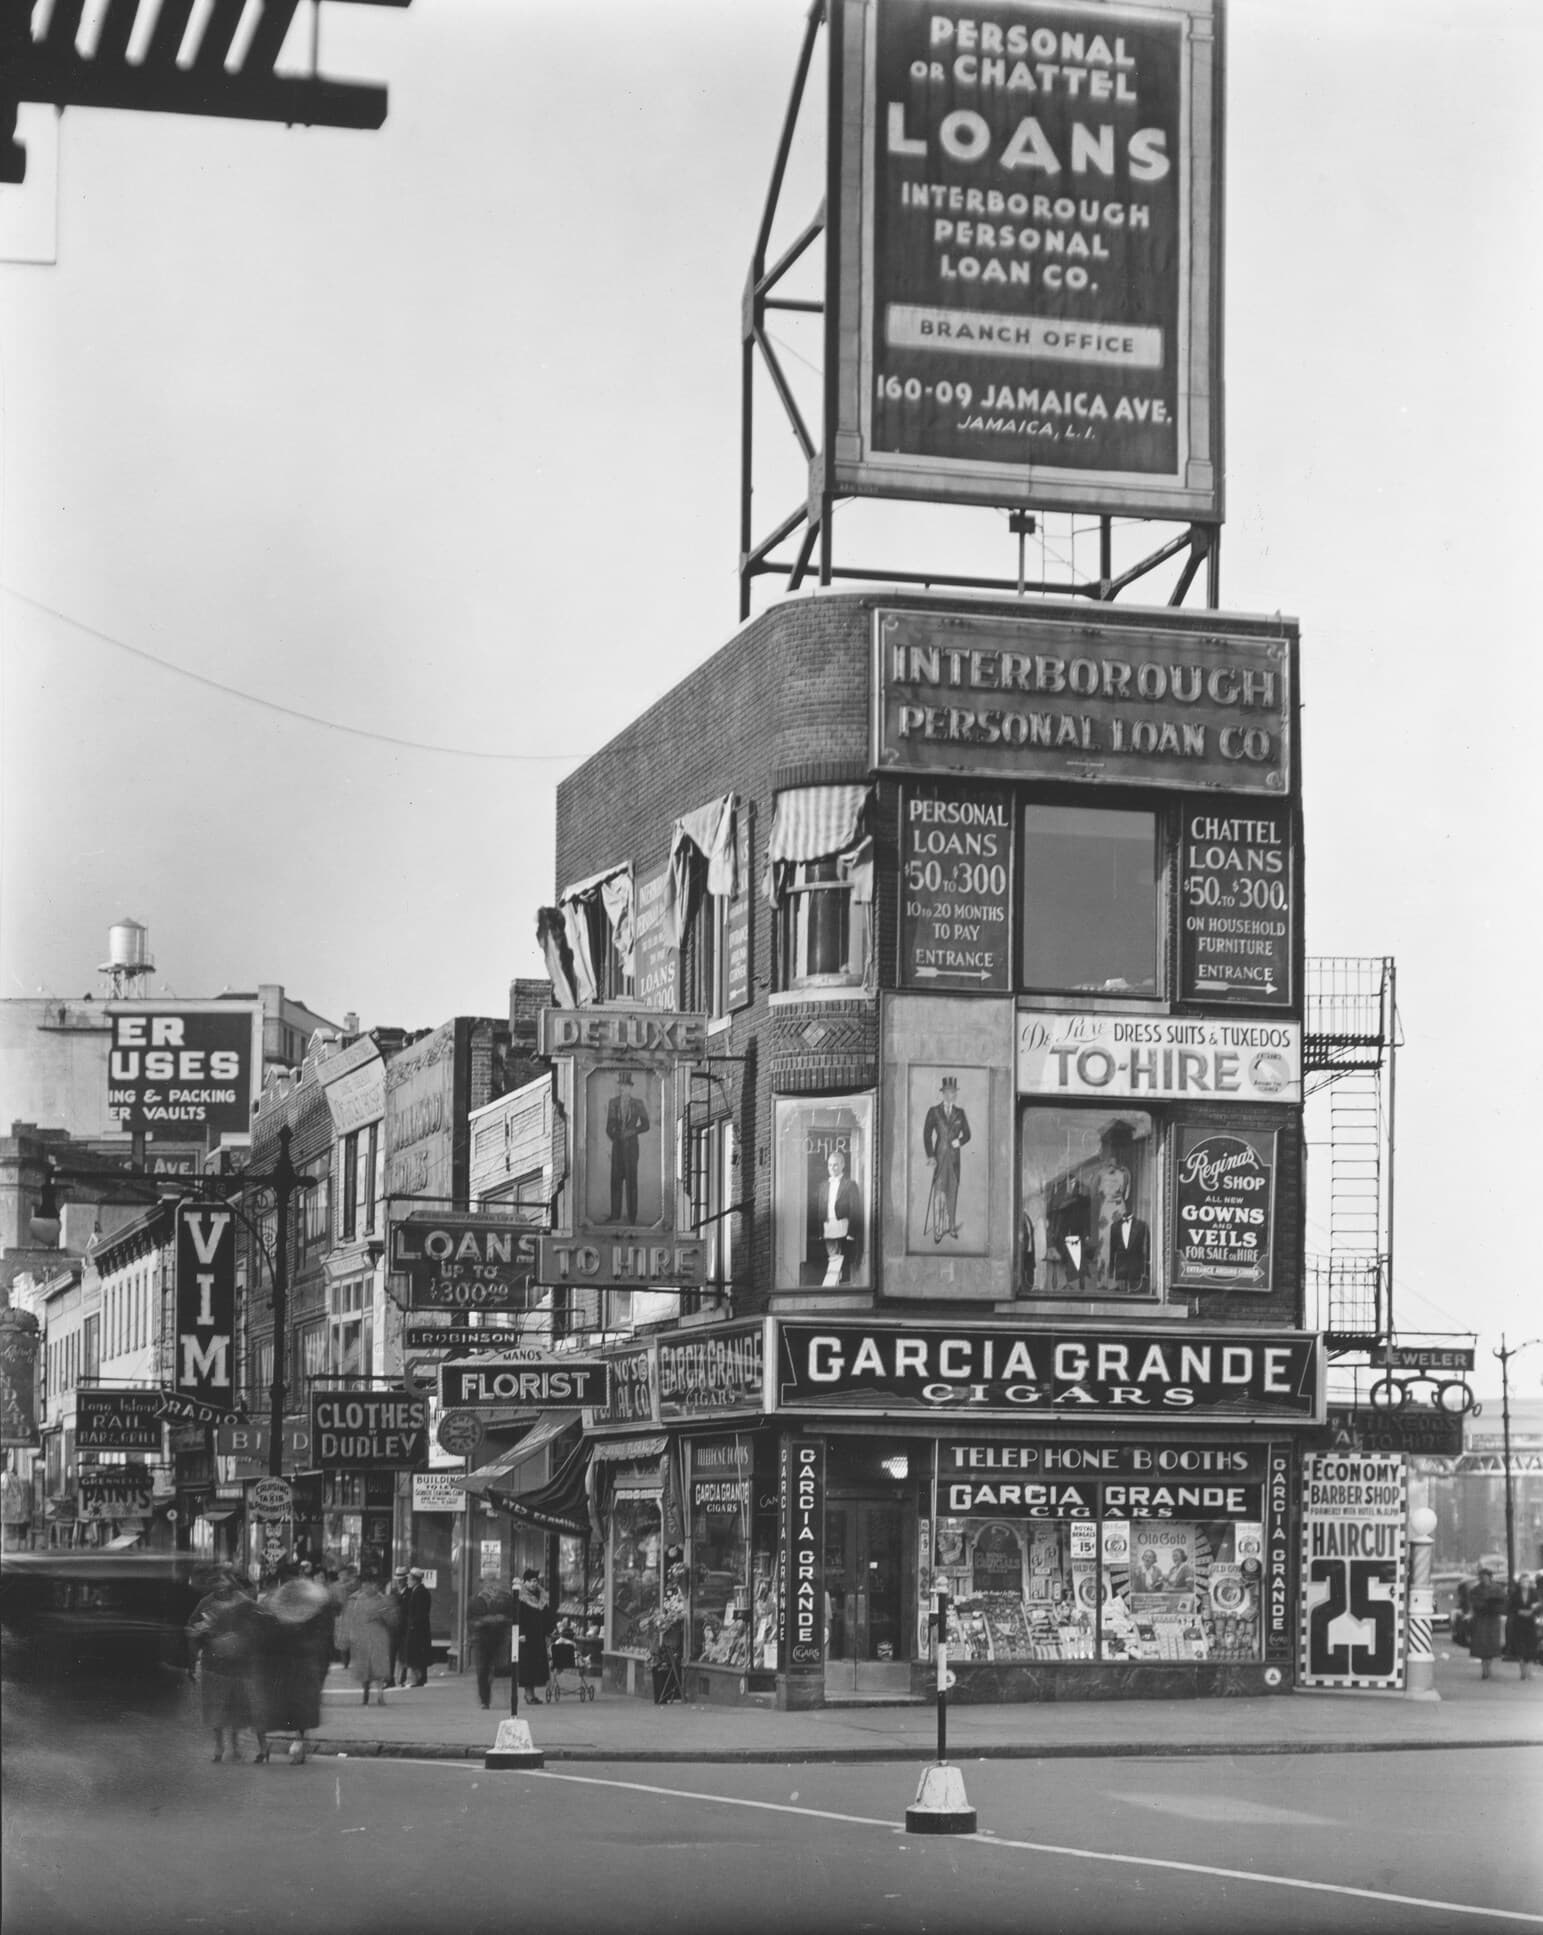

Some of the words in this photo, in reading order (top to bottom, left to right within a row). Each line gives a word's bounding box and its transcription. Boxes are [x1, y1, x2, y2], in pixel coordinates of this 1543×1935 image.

[930, 15, 1136, 66] PERSONAL
[910, 59, 945, 81] OR
[954, 53, 1138, 101] CHATTEL
[886, 100, 1171, 182] LOANS
[900, 180, 1150, 229] INTERBOROUGH
[934, 217, 1110, 259] PERSONAL
[939, 254, 1030, 284] LOAN
[1042, 263, 1099, 291] CO.
[920, 319, 1031, 345] BRANCH
[1042, 330, 1135, 354] OFFICE
[877, 374, 973, 409] 160-09
[979, 384, 1109, 422] JAMAICA
[1113, 396, 1173, 425] AVE.
[956, 415, 1060, 440] JAMAICA,
[892, 644, 1275, 707] INTERBOROUGH
[897, 704, 1101, 750] PERSONAL
[1112, 718, 1206, 756] LOAN
[909, 799, 1009, 827] PERSONAL
[1191, 816, 1281, 844] CHATTEL
[913, 829, 997, 857] LOANS
[1189, 846, 1283, 873] LOANS
[904, 860, 942, 891] $50
[953, 862, 1006, 895] $300
[906, 901, 921, 917] 10
[933, 903, 952, 919] 20
[954, 904, 1005, 922] MONTHS
[933, 922, 950, 940] TO
[953, 924, 980, 941] PAY
[1186, 916, 1204, 931] ON
[1208, 918, 1286, 936] HOUSEHOLD
[916, 948, 994, 968] ENTRANCE
[1197, 937, 1273, 956] FURNITURE
[1198, 965, 1275, 981] ENTRANCE
[118, 1016, 186, 1047] ER
[554, 1018, 600, 1049] DE
[611, 1019, 699, 1051] LUXE
[1113, 1023, 1162, 1043] DRESS
[1167, 1026, 1205, 1045] SUITS
[1209, 1033, 1218, 1045] &
[1221, 1027, 1290, 1047] TUXEDOS
[111, 1051, 240, 1081] USES
[110, 1089, 137, 1104] ING
[144, 1089, 162, 1103] &
[168, 1089, 237, 1104] PACKING
[110, 1106, 132, 1121] ER
[142, 1106, 207, 1121] VAULTS
[153, 1158, 195, 1176] AVE.
[1223, 1175, 1266, 1191] SHOP
[1205, 1195, 1221, 1203] ALL
[1224, 1196, 1244, 1204] NEW
[1181, 1205, 1265, 1224] GOWNS
[396, 1230, 535, 1264] LOANS
[1188, 1229, 1258, 1248] VEILS
[553, 1244, 601, 1277] TO
[612, 1246, 697, 1277] HIRE
[1186, 1246, 1205, 1259] FOR
[1206, 1248, 1229, 1261] SALE
[1237, 1249, 1260, 1262] HIRE
[441, 1264, 464, 1279] UP
[473, 1264, 498, 1279] TO
[180, 1211, 231, 1387] VIM
[421, 1332, 516, 1344] ROBINSON
[503, 1350, 542, 1361] MANOS
[661, 1344, 707, 1397] GARCIA
[707, 1332, 762, 1388] GRANDE
[807, 1336, 1040, 1382] GARCIA
[1053, 1342, 1293, 1393] GRANDE
[1377, 1352, 1468, 1366] JEWELER
[461, 1371, 591, 1401] FLORIST
[685, 1391, 735, 1406] CIGARS
[921, 1384, 1196, 1407] CIGARS
[92, 1414, 147, 1430] RAIL
[166, 1400, 239, 1427] RADIO
[317, 1402, 424, 1429] CLOTHES
[231, 1431, 309, 1451] BID
[321, 1432, 417, 1458] DUDLEY
[1132, 1449, 1249, 1471] BOOTHS
[1311, 1460, 1400, 1482] ECONOMY
[81, 1488, 151, 1512] PAINTS
[255, 1482, 289, 1496] CRUISING
[261, 1495, 284, 1504] TAXIS
[696, 1483, 720, 1506] GARCIA
[721, 1481, 750, 1505] GRANDE
[798, 1449, 817, 1540] GARCIA
[949, 1484, 1085, 1511] GARCIA
[1105, 1486, 1247, 1512] GRANDE
[1272, 1458, 1287, 1540] GARCIA
[1310, 1485, 1363, 1505] BARBER
[1364, 1485, 1400, 1505] SHOP
[501, 1498, 528, 1515] EYES
[706, 1503, 738, 1513] CIGARS
[1029, 1507, 1174, 1519] CIGARS
[1138, 1532, 1159, 1545] Old
[1160, 1532, 1186, 1545] Gold
[1311, 1522, 1399, 1558] HAIRCUT
[797, 1550, 816, 1642] GRANDE
[1272, 1549, 1286, 1631] GRANDE
